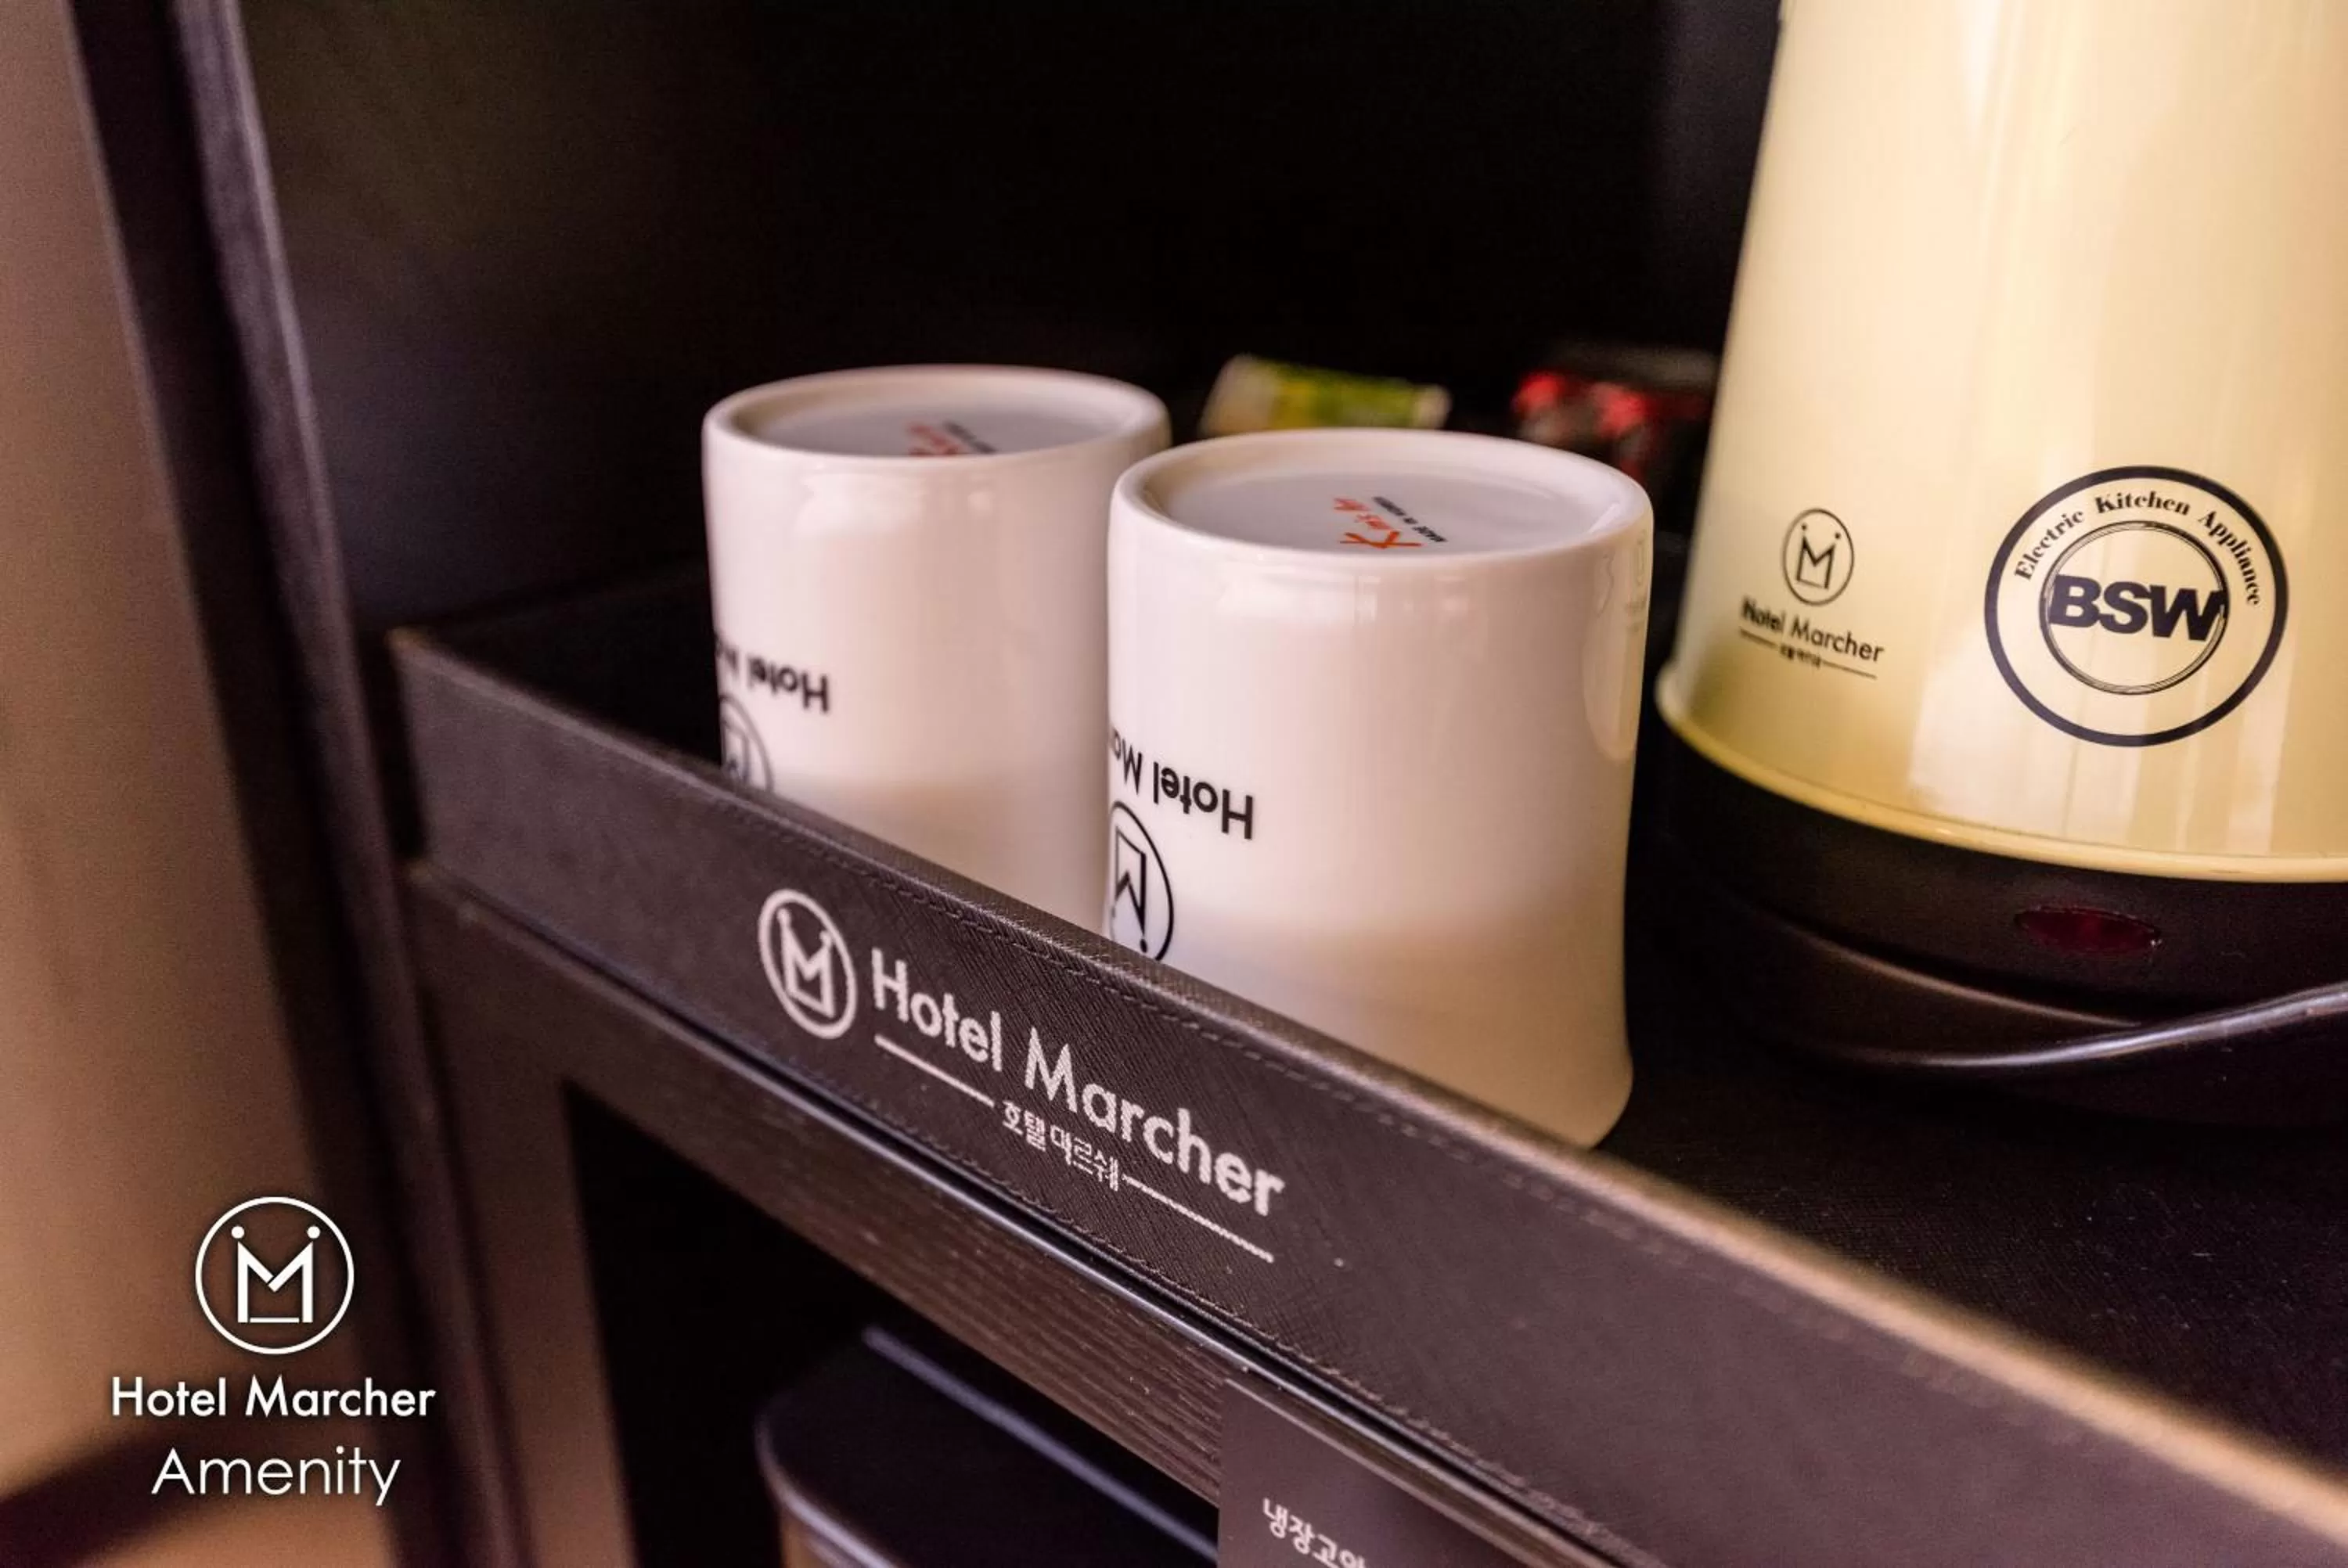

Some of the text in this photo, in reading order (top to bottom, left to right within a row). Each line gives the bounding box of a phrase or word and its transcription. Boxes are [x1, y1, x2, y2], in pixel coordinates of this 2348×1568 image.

[2014, 491, 2261, 608] Electric Kitchen Appliance
[1791, 614, 1885, 663] Marcher
[2047, 574, 2228, 642] BSW
[747, 656, 829, 714] Hotel
[1153, 761, 1253, 840] Hotel
[871, 947, 1286, 1217] Hotel Marcher
[1003, 1100, 1046, 1153] 호텔
